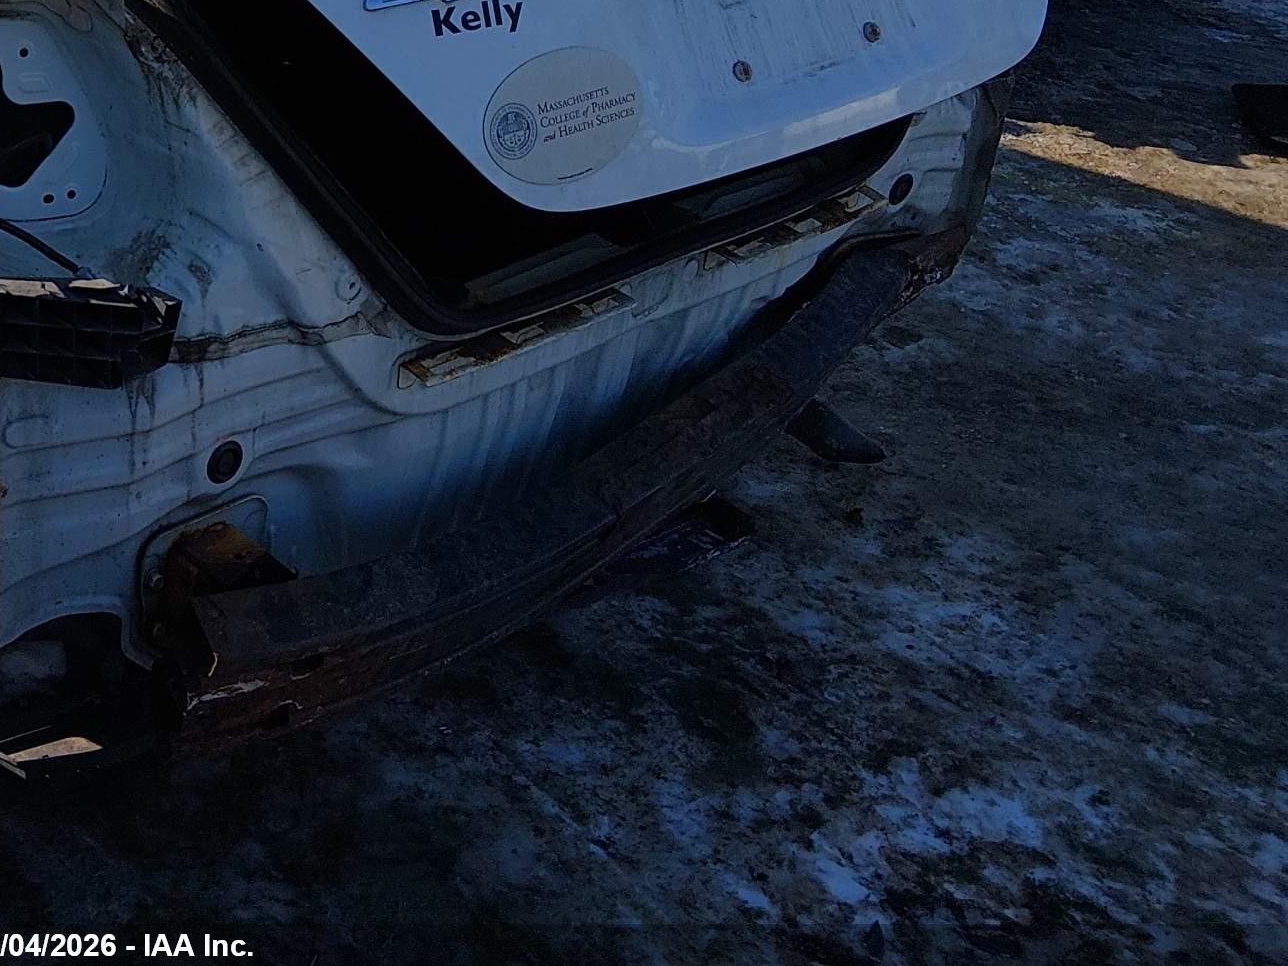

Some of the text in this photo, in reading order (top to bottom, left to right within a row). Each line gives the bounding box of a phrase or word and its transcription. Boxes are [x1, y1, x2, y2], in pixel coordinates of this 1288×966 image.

[537, 87, 609, 114] MASSACHUSETTS
[540, 92, 636, 129] COLLEGE of PHARMACY
[543, 107, 635, 143] and HEALTH SCIENCES
